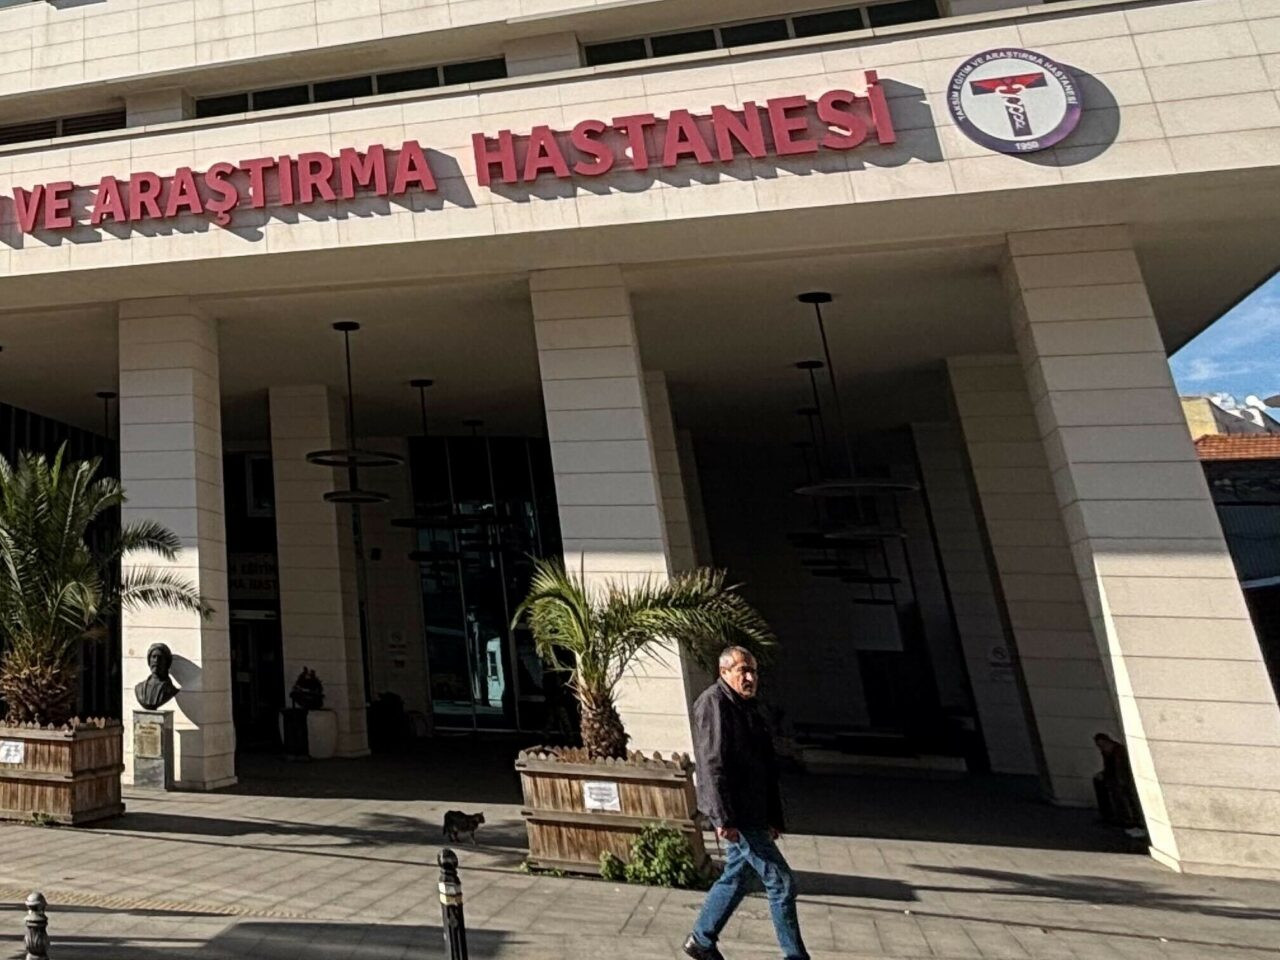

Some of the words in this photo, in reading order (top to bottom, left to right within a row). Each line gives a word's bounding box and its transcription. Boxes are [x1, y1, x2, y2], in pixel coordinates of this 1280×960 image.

[951, 91, 966, 121] TAKSİM
[970, 57, 986, 67] VE
[12, 181, 74, 234] VE
[90, 140, 438, 227] ARAŞTIRMA
[471, 70, 897, 187] HASTANESİ
